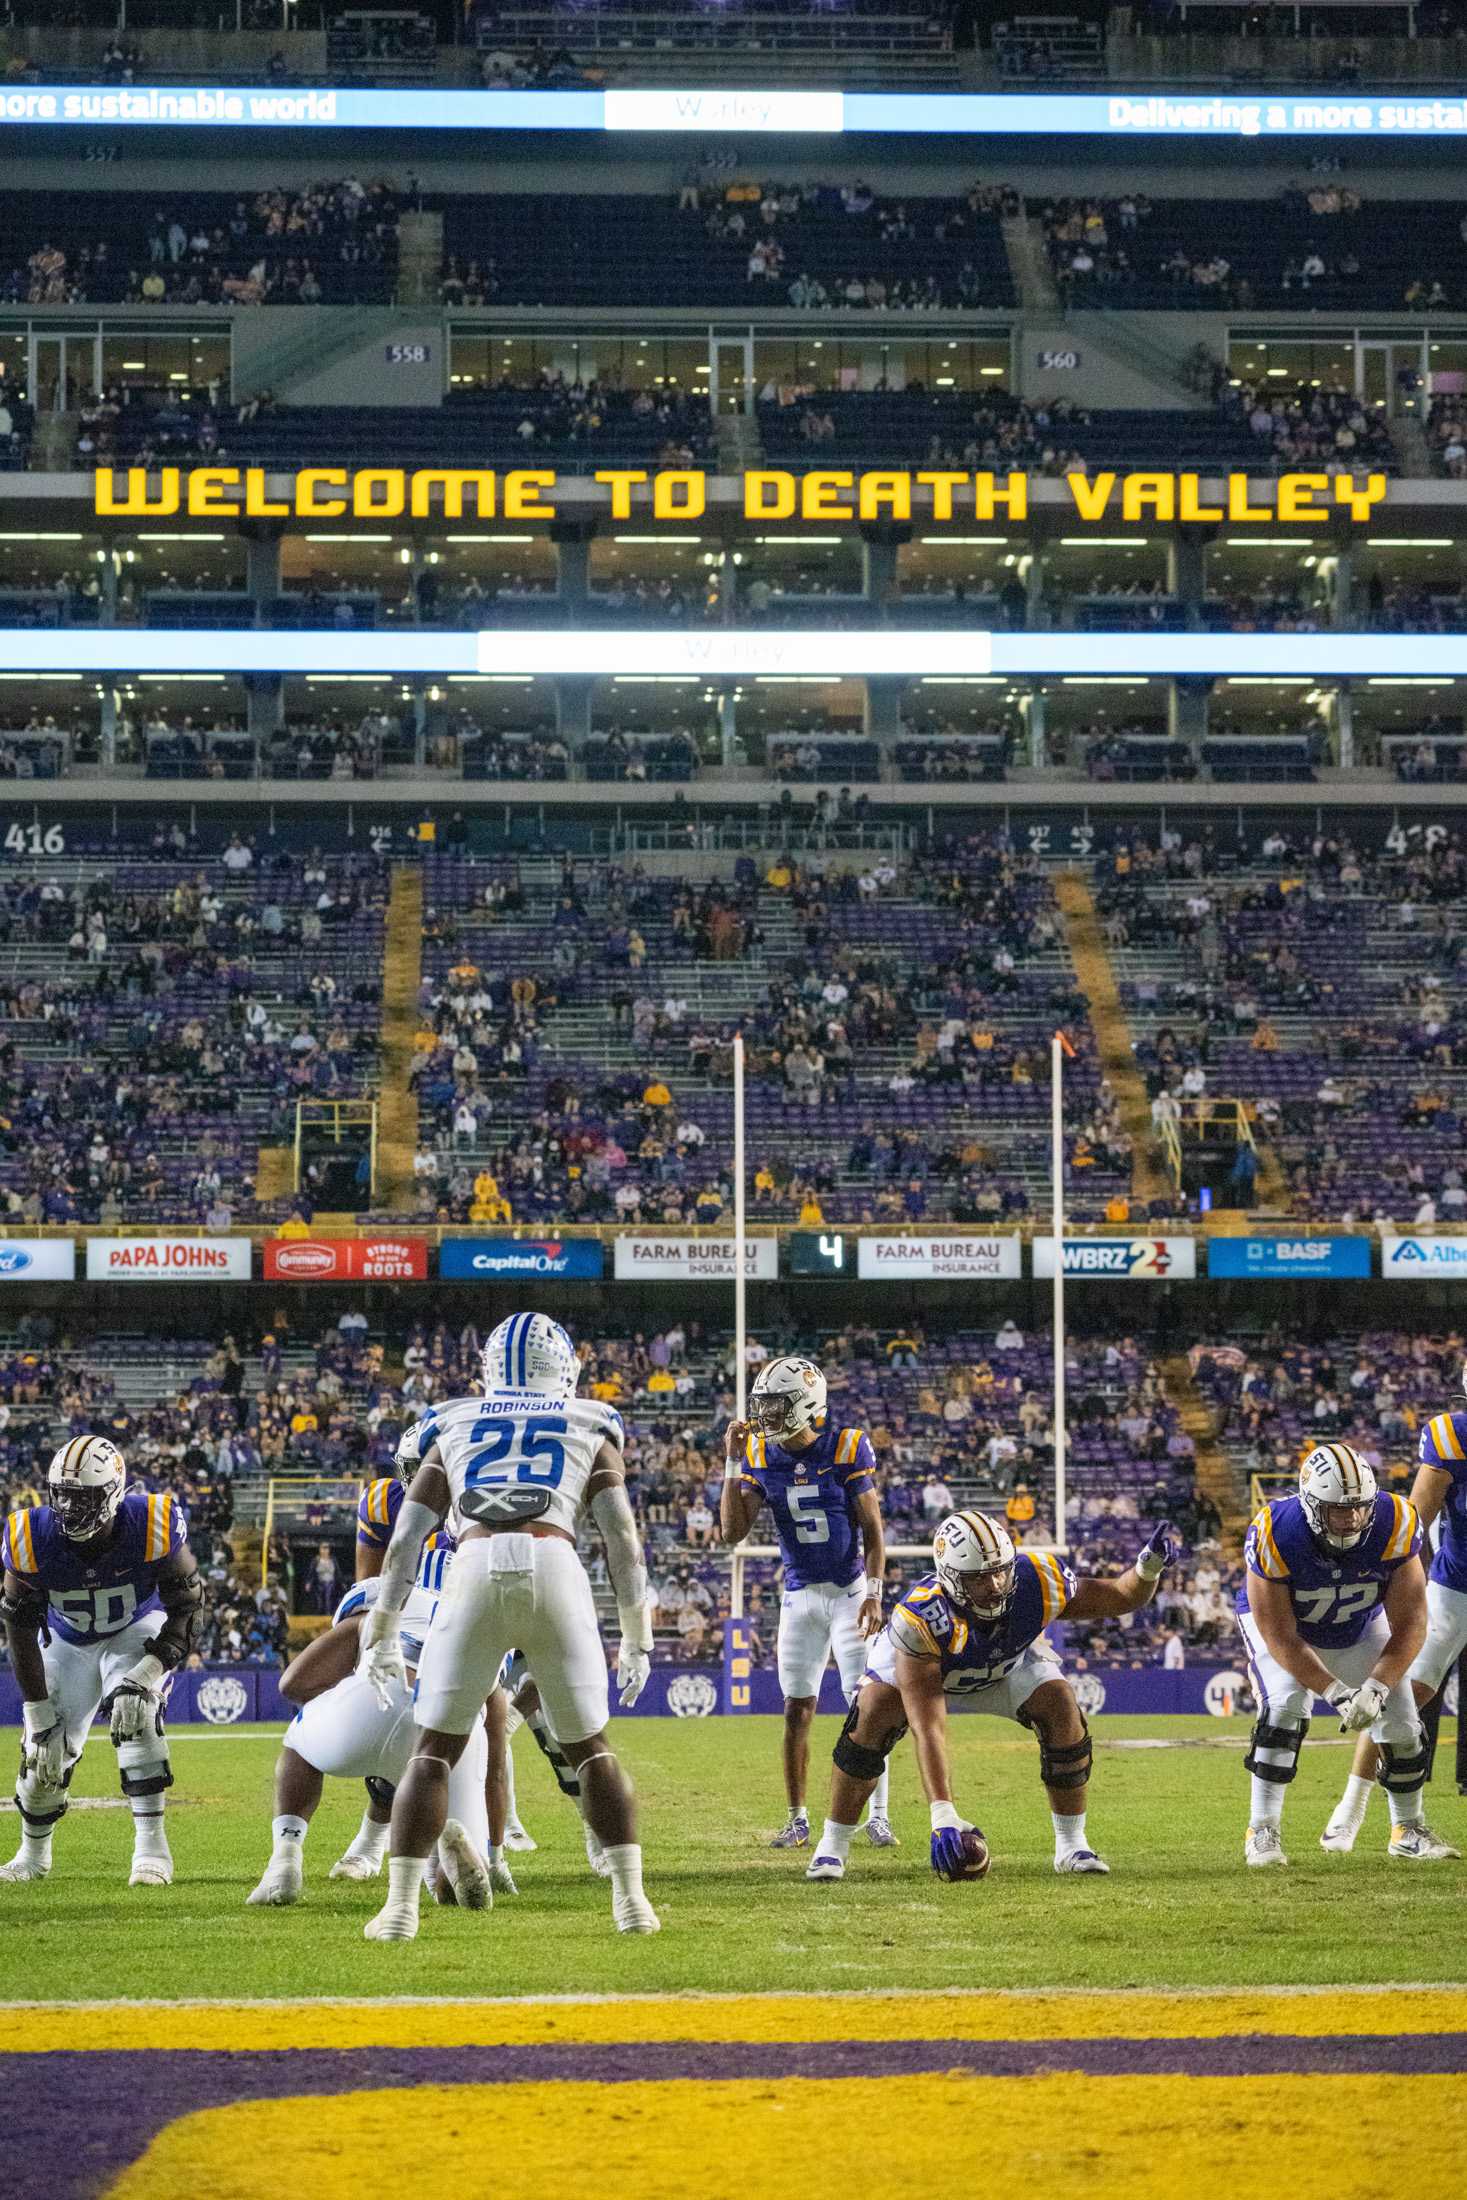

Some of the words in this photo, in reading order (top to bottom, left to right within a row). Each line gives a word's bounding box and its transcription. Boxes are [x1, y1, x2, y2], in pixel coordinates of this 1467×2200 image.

[0, 94, 57, 118] ore
[63, 89, 243, 119] sustainable
[250, 91, 337, 121] world
[1108, 98, 1261, 135] Delivering
[1267, 105, 1286, 129] a
[1293, 105, 1373, 129] more
[391, 345, 425, 362] 558
[1043, 352, 1076, 369] 560
[95, 467, 556, 518] WELCOME
[595, 470, 706, 519] TO
[743, 470, 1027, 520] DEATH
[1067, 472, 1387, 522] VALLEY
[4, 823, 65, 854] 416
[369, 825, 393, 839] 416
[1028, 825, 1051, 838] 417
[109, 1246, 159, 1266] PAPA
[162, 1244, 228, 1266] JOHNS
[633, 1244, 681, 1258] FARM
[819, 1235, 843, 1268] 4
[876, 1244, 924, 1258] FARM
[931, 1243, 1000, 1258] BUREAU
[1060, 1247, 1128, 1269] WBRZ
[1276, 1242, 1332, 1260] BASF
[363, 1262, 413, 1276] ROOTS
[689, 1263, 757, 1274] INSURACE
[932, 1263, 1000, 1273] INSURANCE
[480, 1401, 565, 1415] ROBINSON
[465, 1416, 568, 1490] 25
[786, 1485, 830, 1544] 5
[48, 1583, 137, 1633] 50
[1295, 1582, 1379, 1624] 72
[731, 1628, 751, 1706] LSU
